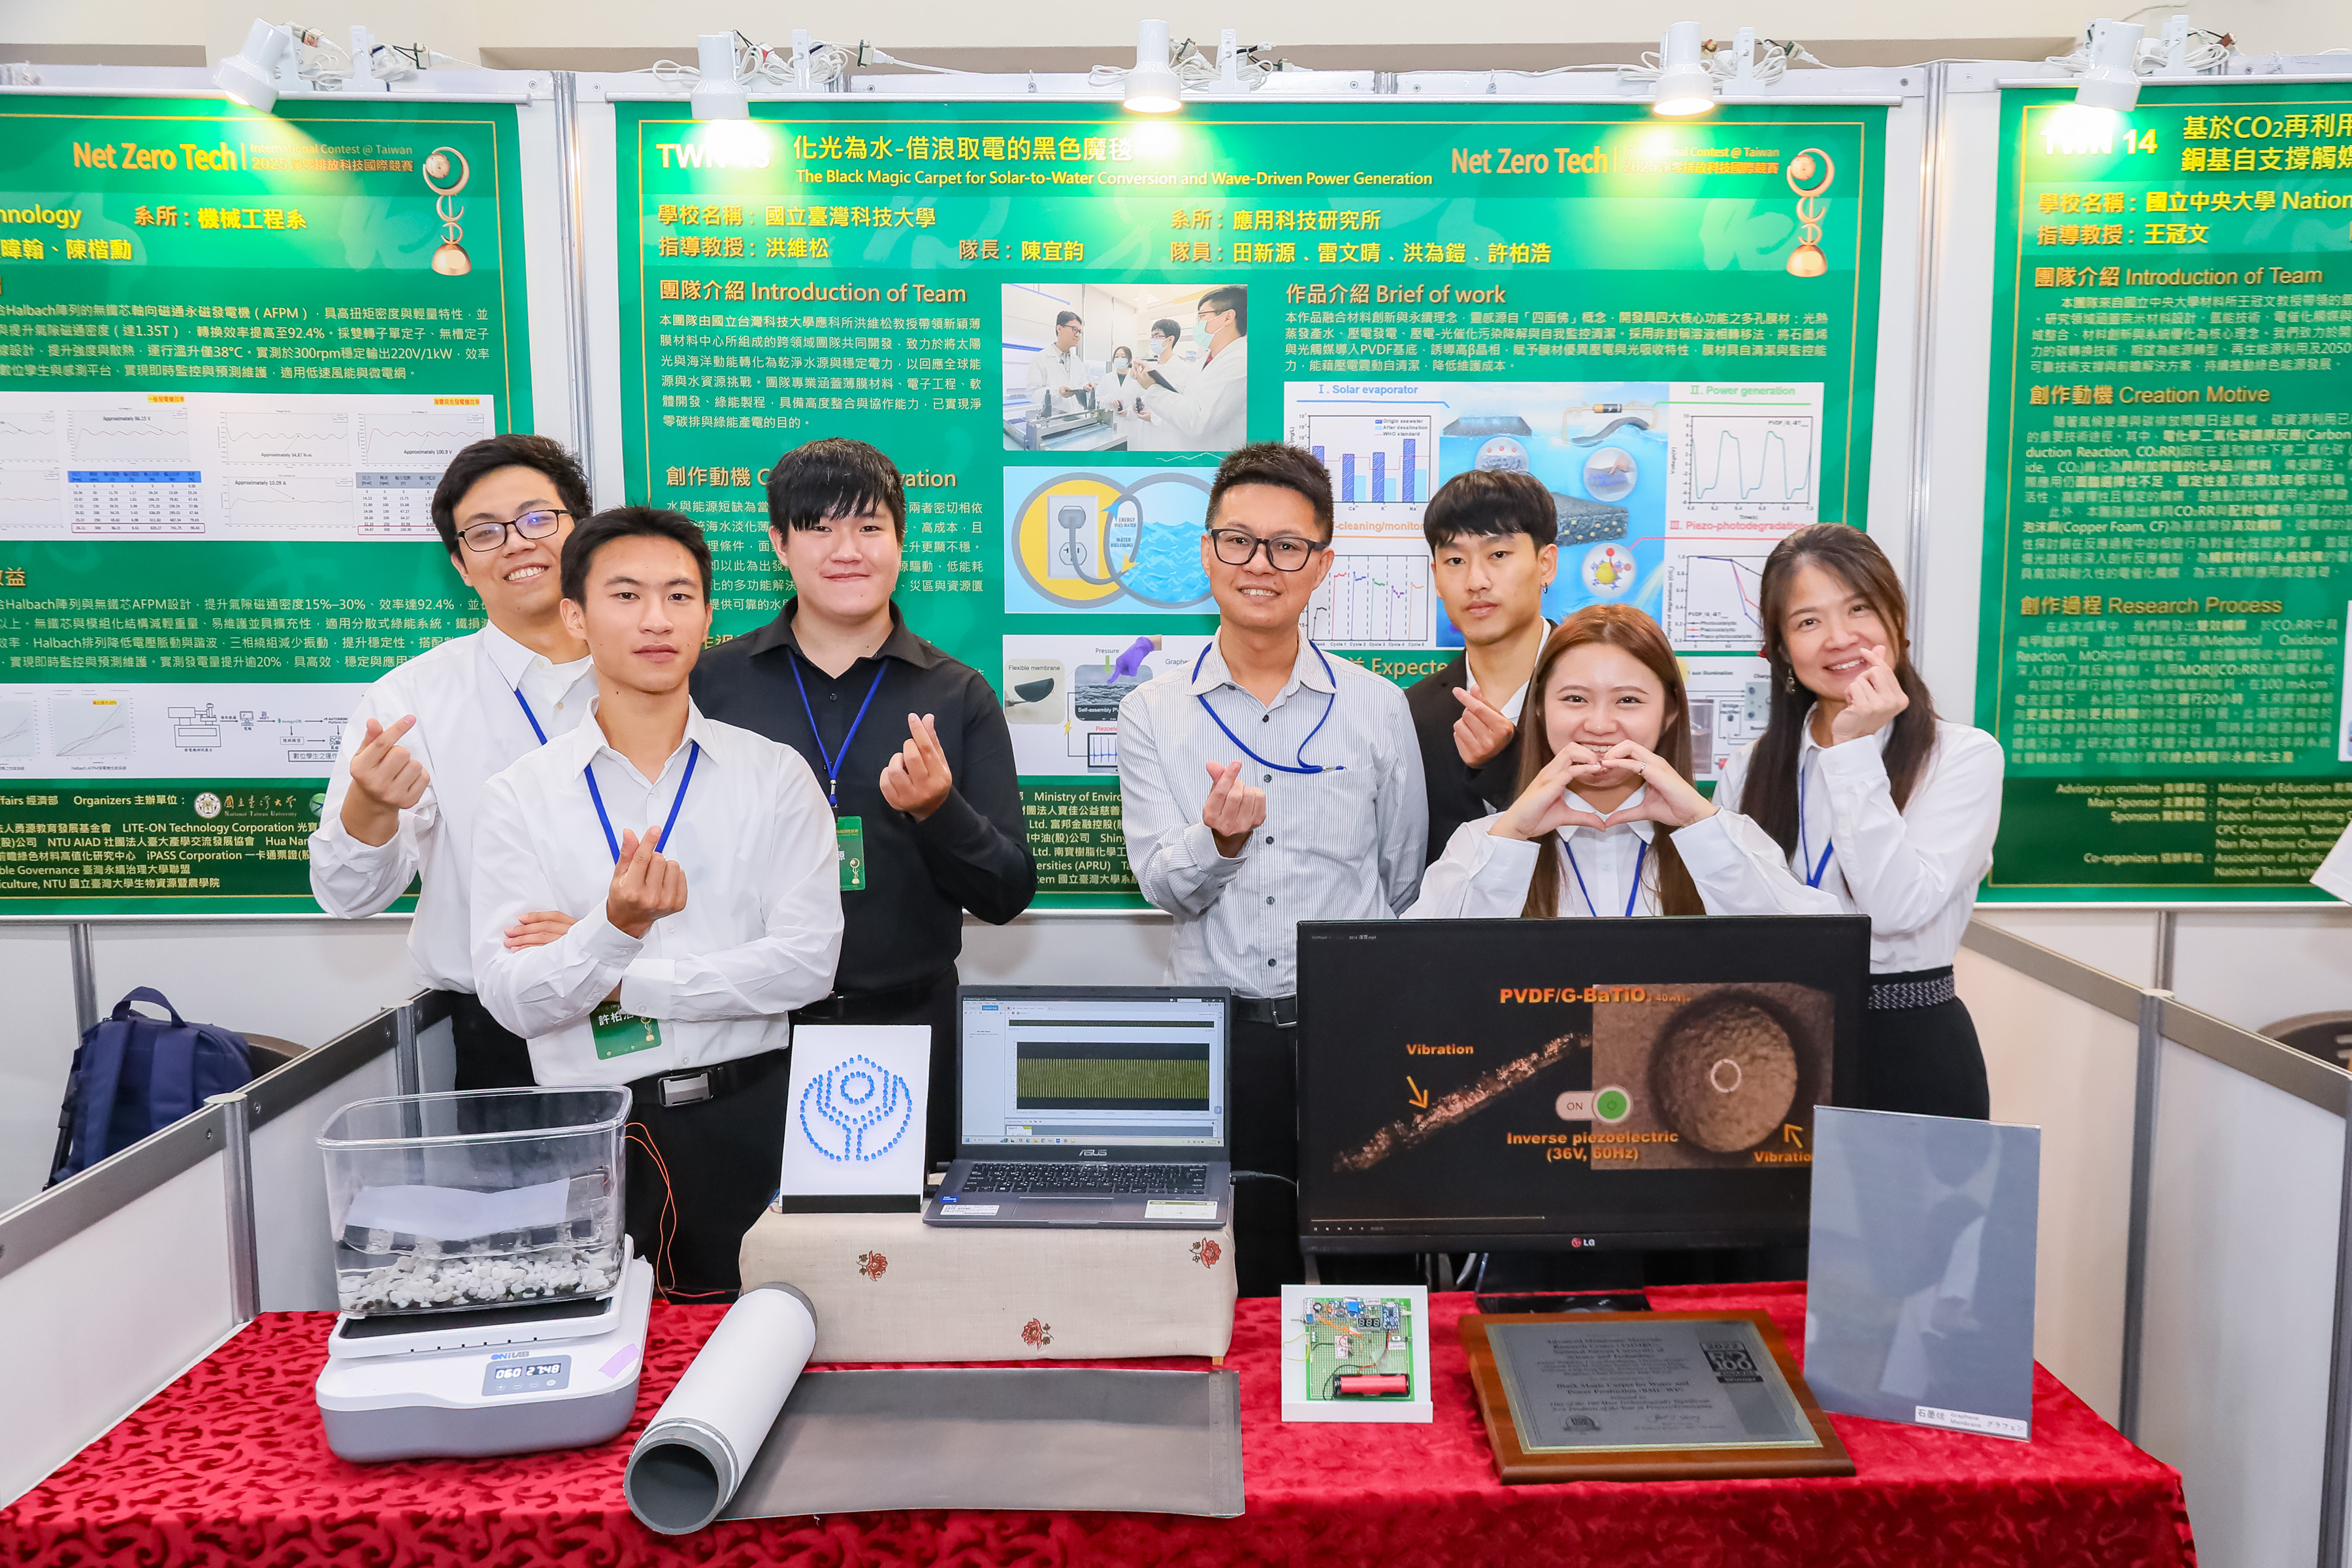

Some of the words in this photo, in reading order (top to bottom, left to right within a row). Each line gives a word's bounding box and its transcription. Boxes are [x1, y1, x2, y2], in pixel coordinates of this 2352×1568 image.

[2123, 129, 2158, 154] 14
[250, 143, 319, 154] International
[321, 144, 360, 154] Contest
[363, 145, 374, 155] @
[376, 144, 413, 155] Taiwan
[1690, 147, 1730, 157] Contest
[1731, 148, 1742, 159] @
[1743, 147, 1780, 157] Taiwan
[73, 142, 118, 169] Net
[121, 143, 176, 171] Zero
[180, 142, 237, 171] Tech
[1451, 148, 1492, 174] Net
[1495, 148, 1549, 174] Zero
[1554, 146, 1609, 174] Tech
[796, 169, 823, 184] The
[826, 169, 864, 184] Black
[867, 170, 911, 187] Magic
[914, 171, 962, 188] Carpet
[965, 171, 986, 184] for
[988, 171, 1094, 186] Solar-to-Water
[1097, 171, 1178, 186] Conversion
[1180, 172, 1207, 186] and
[1210, 172, 1303, 186] Wave-Driven
[1305, 172, 1351, 187] Power
[1354, 172, 1433, 188] Generation
[2034, 267, 2121, 288] 團隊介紹
[2126, 268, 2239, 286] Introduction
[2244, 267, 2264, 285] of
[2268, 267, 2324, 284] Team
[659, 279, 746, 302] 團隊介紹
[751, 282, 882, 303] Introduction
[885, 282, 909, 303] of
[912, 284, 968, 304] Team
[1285, 284, 1370, 306] 作品介紹
[1376, 284, 1424, 304] Brief
[1427, 284, 1450, 304] of
[1453, 284, 1507, 305] work
[1332, 385, 1360, 394] Solar
[1362, 385, 1418, 396] evaporator
[1706, 385, 1739, 395] Power
[1741, 386, 1795, 397] generation
[2029, 385, 2114, 406] 創作動機
[2119, 386, 2200, 405] Creation
[2206, 385, 2272, 403] Motive
[666, 466, 751, 487] 創作動機
[2109, 597, 2200, 615] Research
[2206, 596, 2283, 614] Process
[73, 795, 132, 808] Organizers
[1034, 792, 1077, 804] Ministry
[1079, 792, 1090, 802] of
[122, 824, 167, 833] LITE-ON
[169, 823, 229, 834] Technology
[231, 823, 295, 834] Corporation
[1029, 819, 1048, 829] Ltd.
[47, 838, 71, 847] NTU
[265, 836, 286, 846] Hua
[146, 851, 176, 860] iPASS
[180, 850, 242, 862] Corporation
[1033, 847, 1051, 857] Ltd.
[17, 866, 80, 875] Governance
[1075, 860, 1111, 872] (APRU)
[43, 879, 66, 889] NTU
[1406, 1043, 1474, 1056] Vibration
[1567, 1102, 1583, 1111] ON
[1507, 1132, 1567, 1145] Inverse
[1573, 1130, 1679, 1146] piezoelectric
[1546, 1147, 1587, 1162] (36V,
[1592, 1147, 1639, 1162] 60Hz)
[1582, 1238, 1595, 1247] LG
